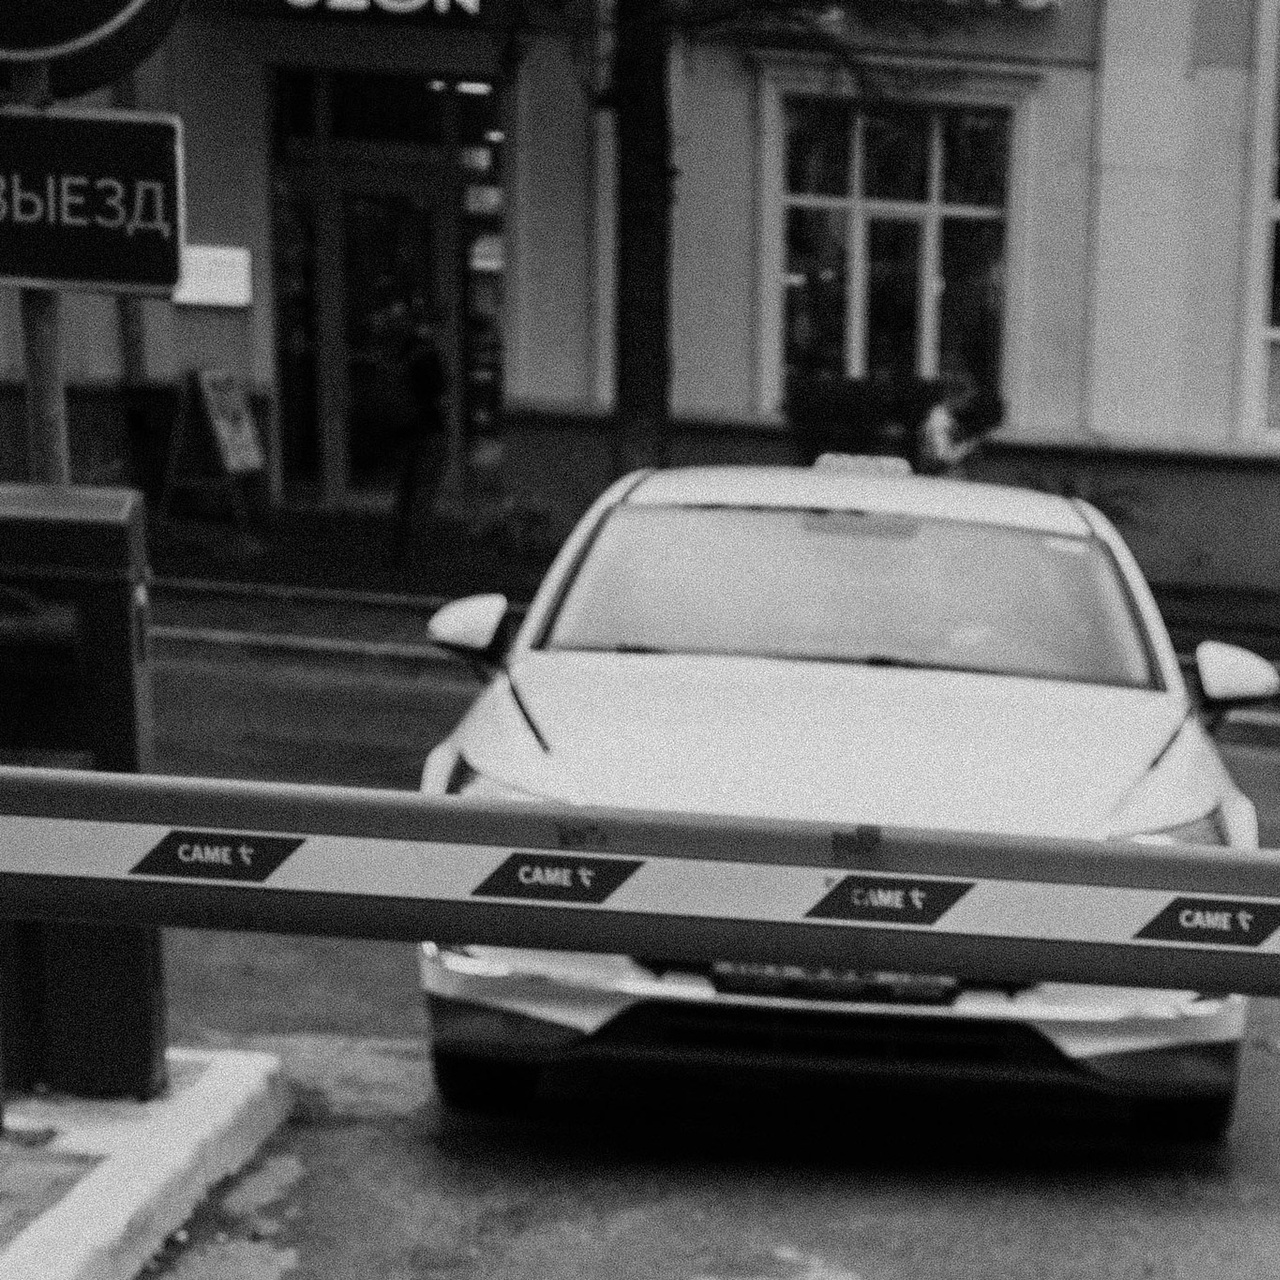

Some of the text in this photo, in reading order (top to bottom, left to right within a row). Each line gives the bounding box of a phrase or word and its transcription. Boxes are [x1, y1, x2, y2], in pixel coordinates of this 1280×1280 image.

[0, 173, 172, 240] ЫЕЗД
[177, 843, 232, 866] CAME
[518, 864, 573, 888] CAME
[1179, 908, 1232, 932] CAME
